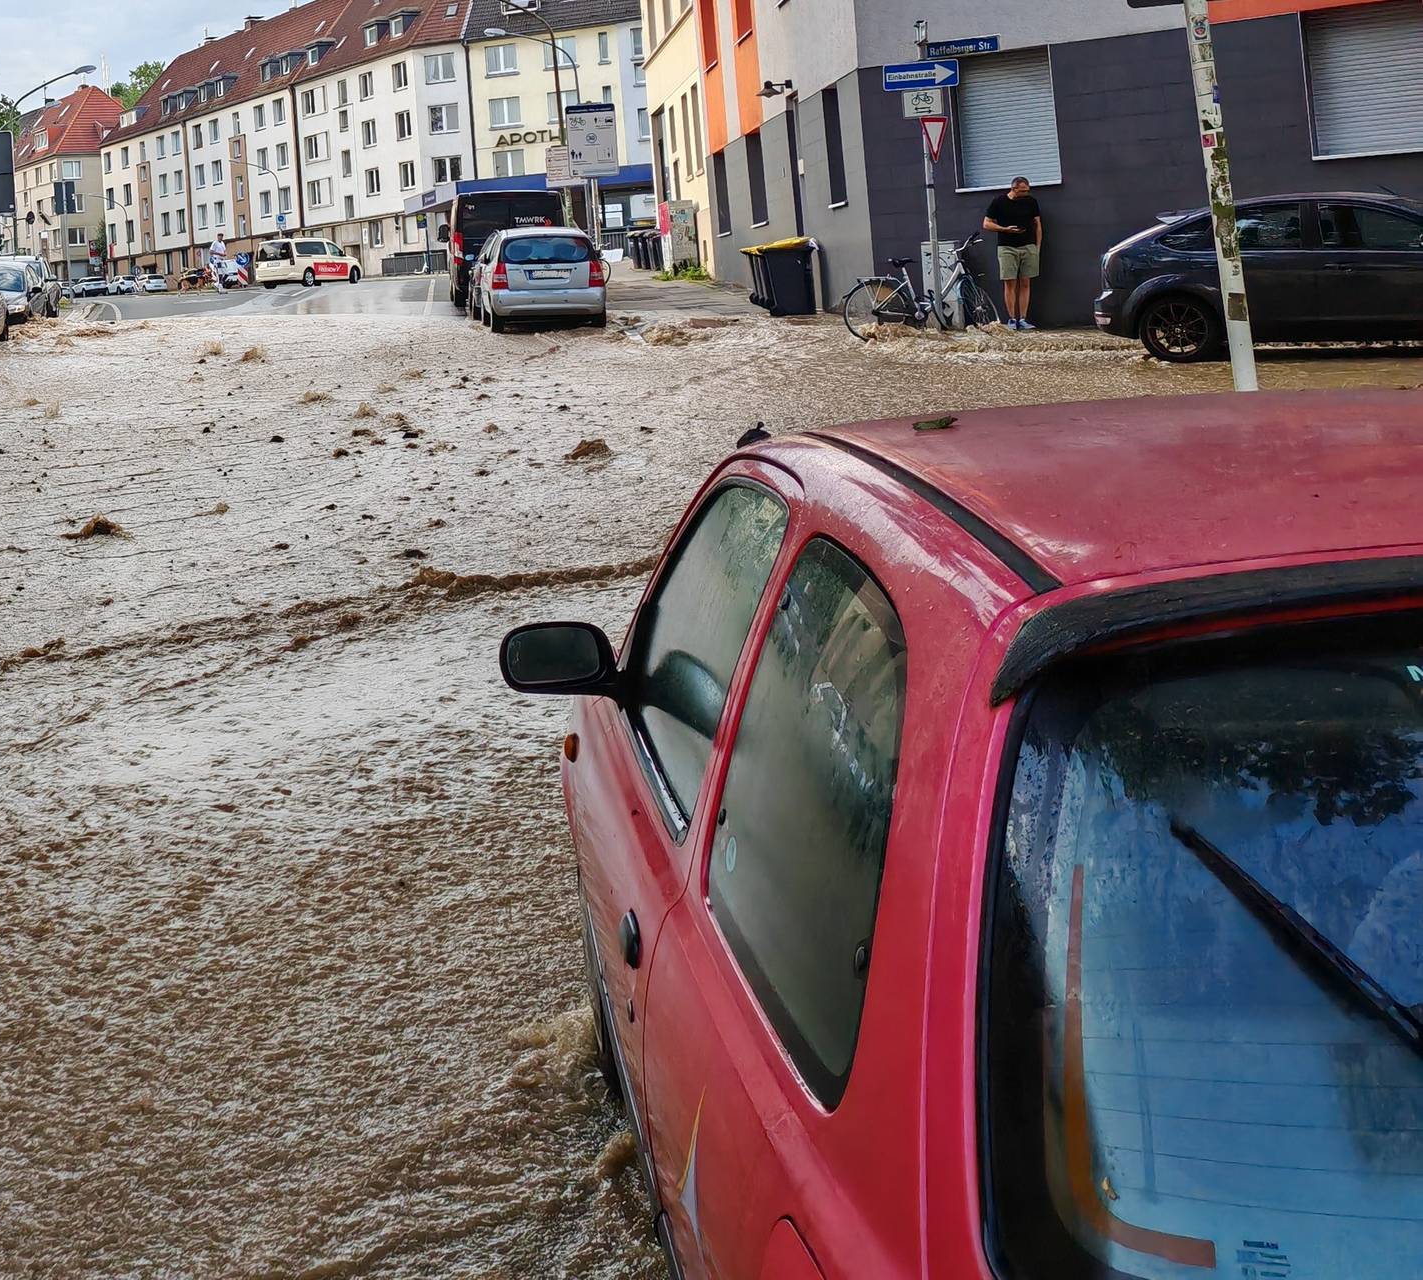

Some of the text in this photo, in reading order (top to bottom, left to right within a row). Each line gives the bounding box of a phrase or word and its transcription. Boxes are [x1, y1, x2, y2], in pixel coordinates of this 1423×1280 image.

[978, 41, 993, 51] Str.
[887, 71, 937, 81] Einbahnstraße
[514, 216, 545, 224] TMWRK
